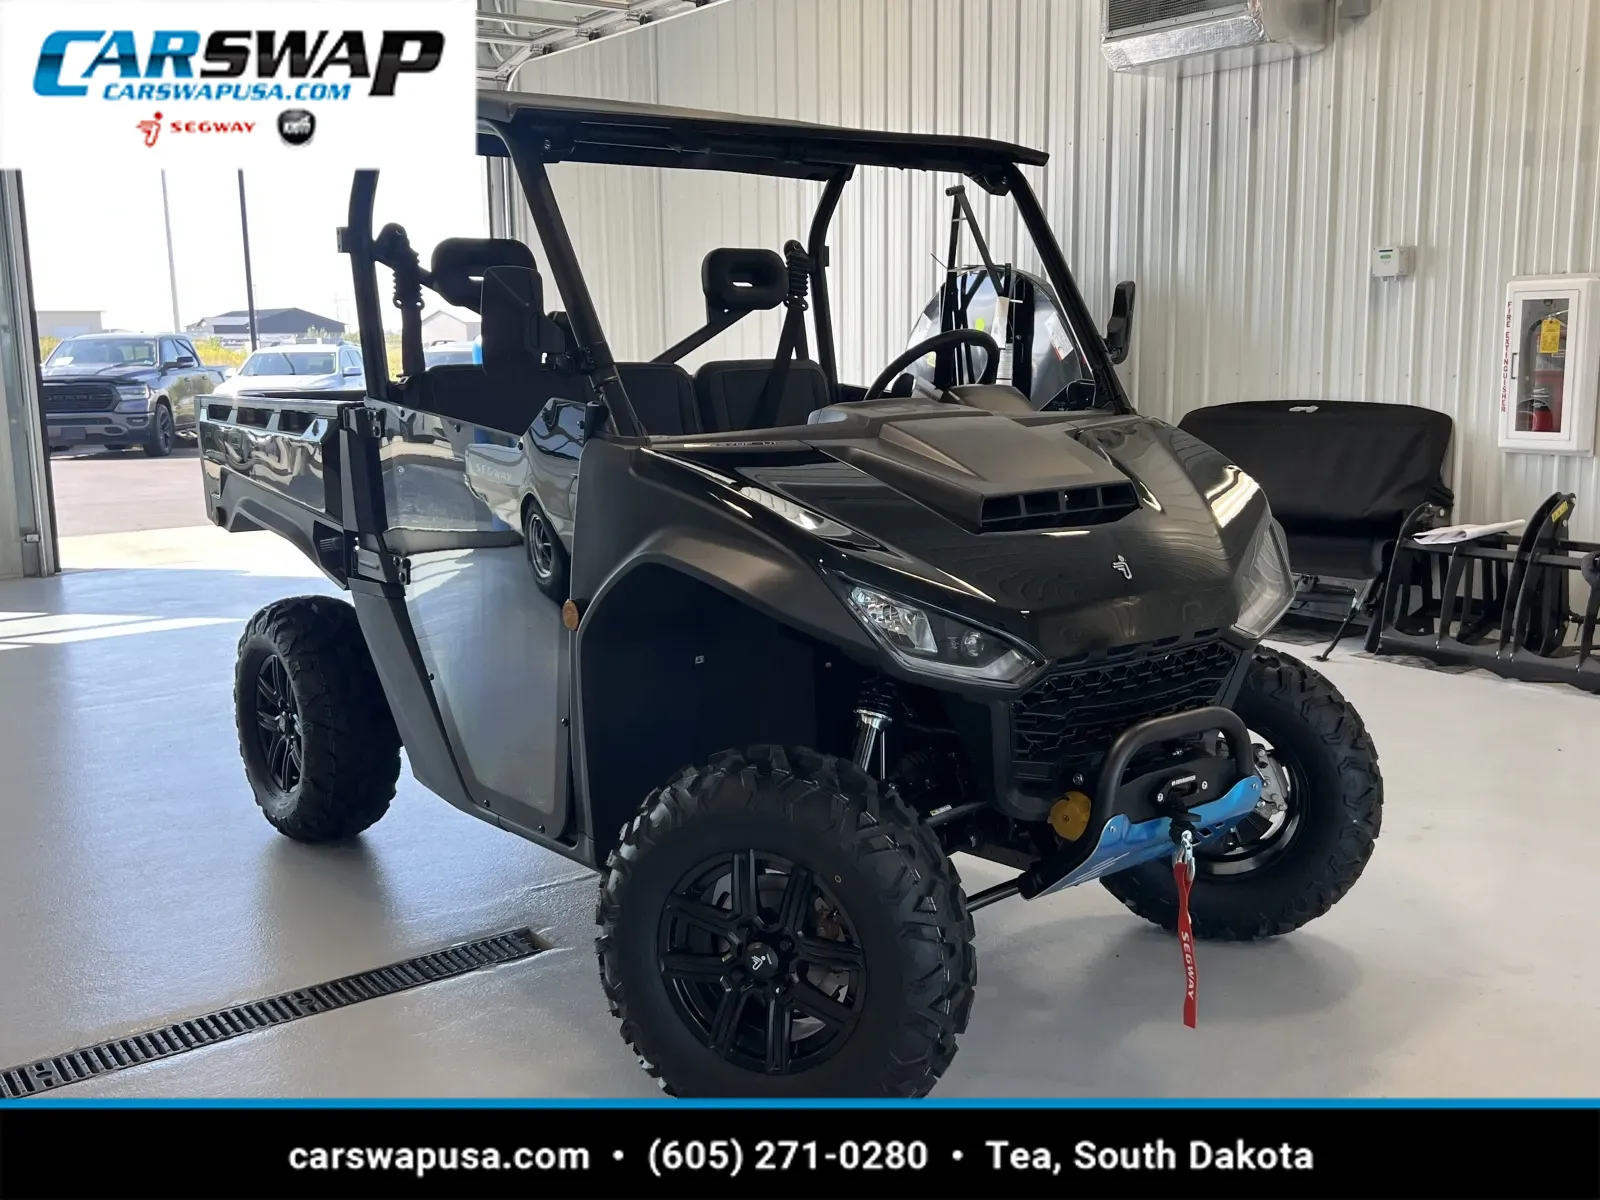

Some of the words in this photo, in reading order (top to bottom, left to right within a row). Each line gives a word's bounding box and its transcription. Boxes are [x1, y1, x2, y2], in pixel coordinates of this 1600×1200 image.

[1500, 331, 1511, 413] EXTINGUISHER
[475, 463, 512, 482] SEGWAY
[1181, 931, 1195, 1000] SEGWAY
